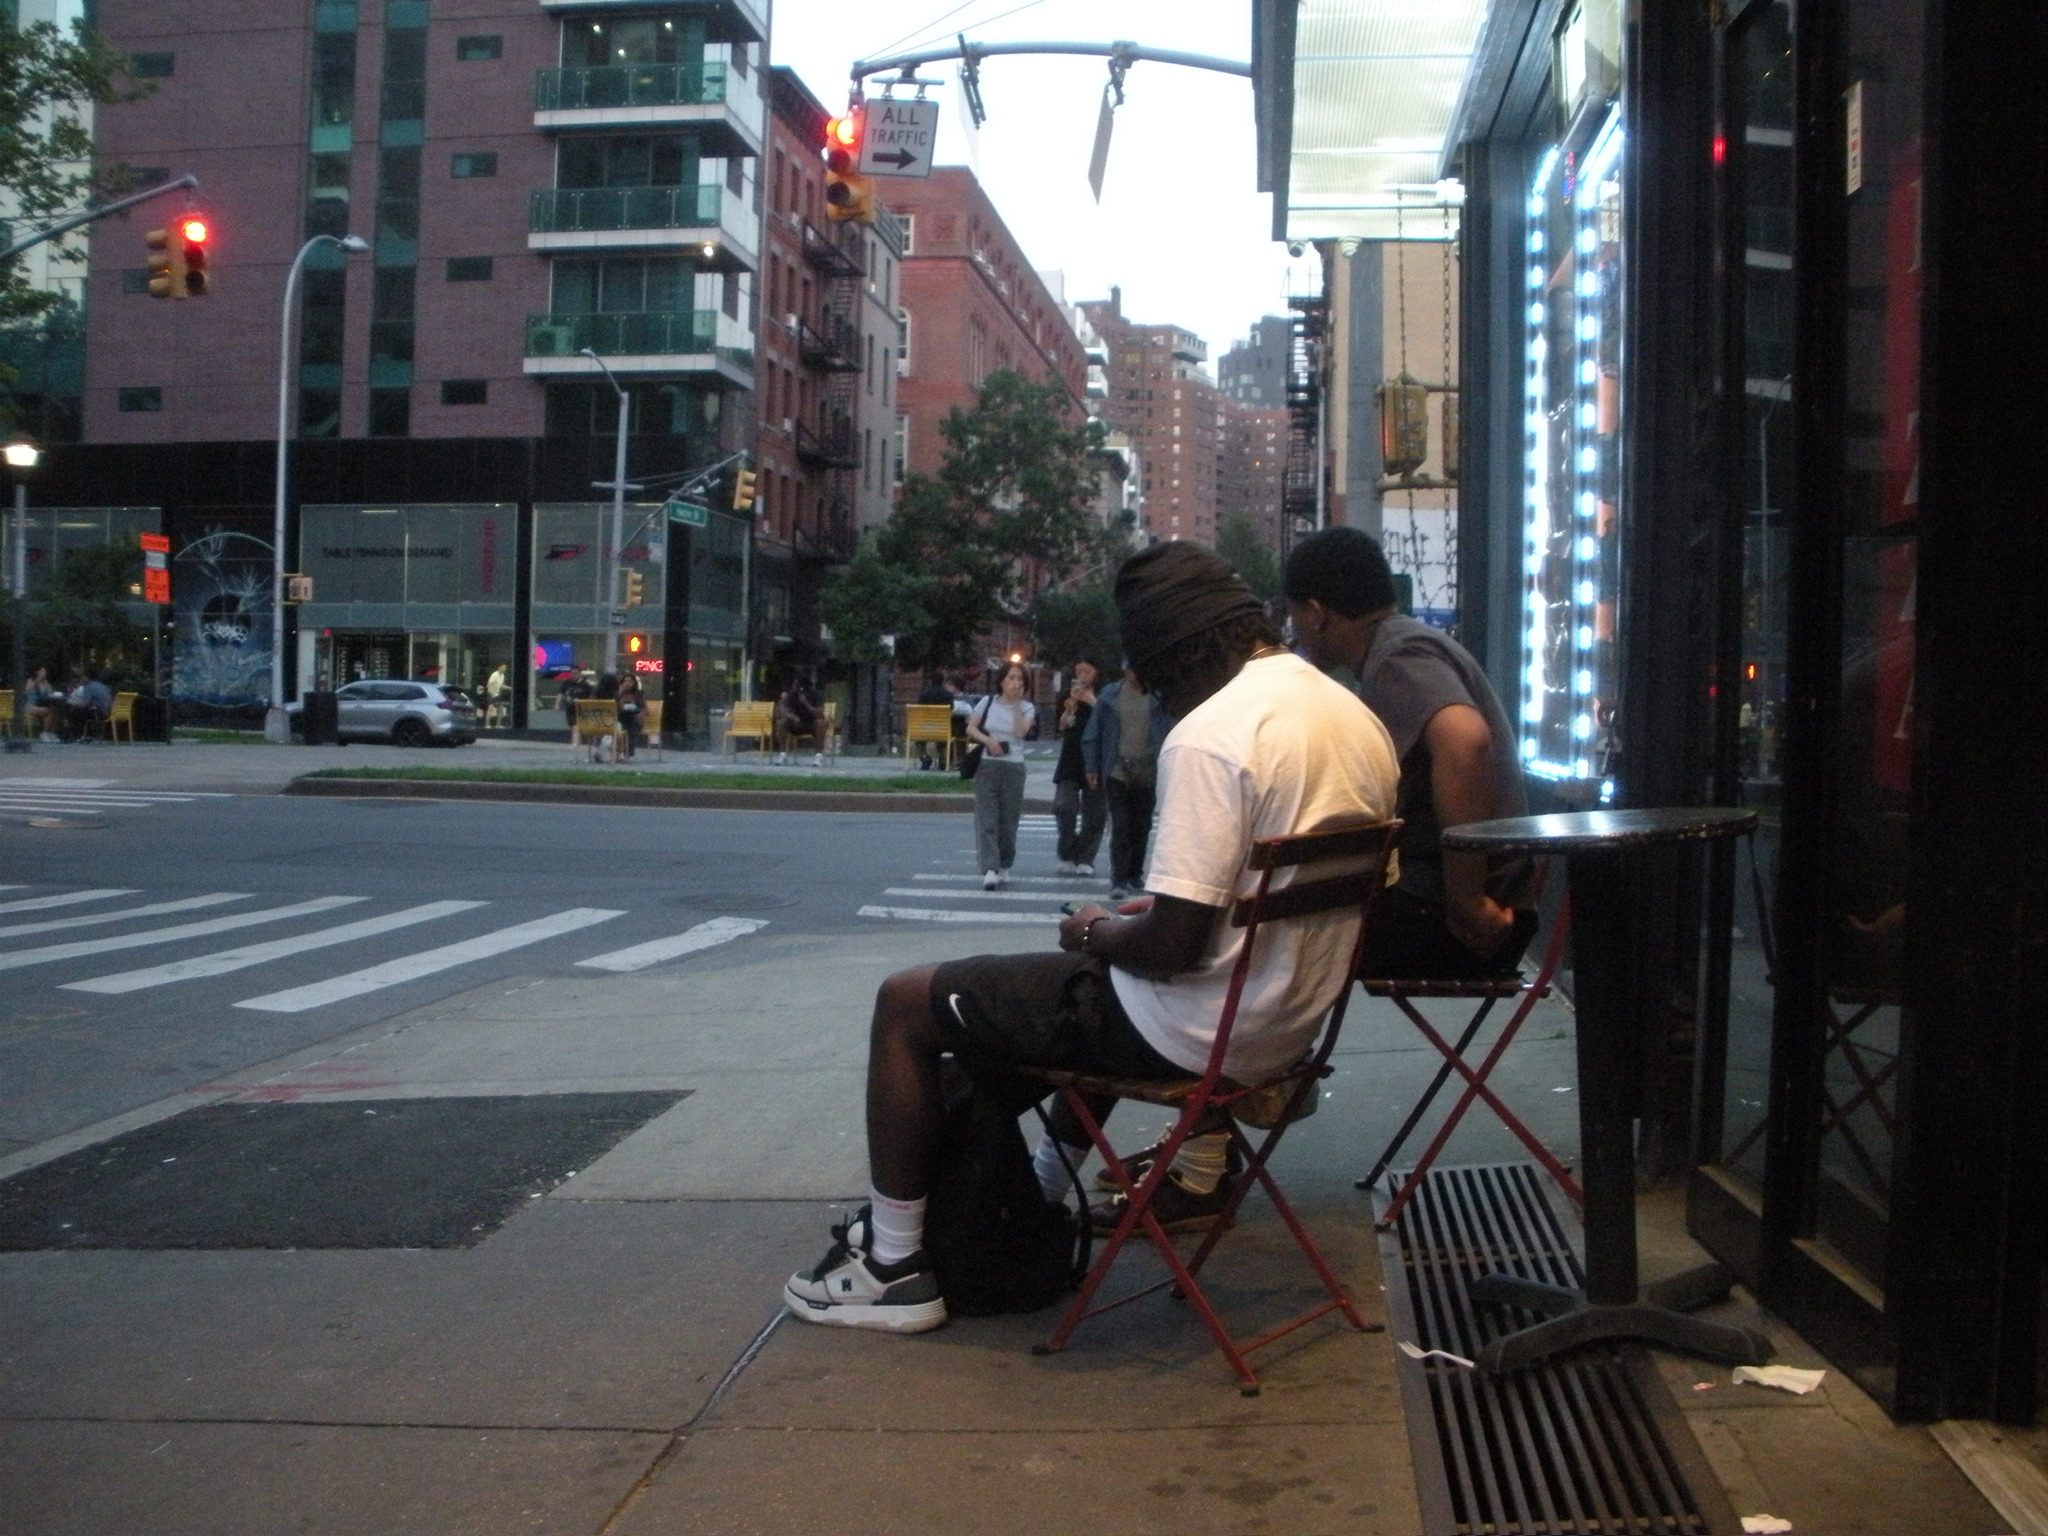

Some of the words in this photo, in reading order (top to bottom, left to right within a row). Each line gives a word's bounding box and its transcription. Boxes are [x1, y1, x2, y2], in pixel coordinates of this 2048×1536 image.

[881, 106, 920, 125] ALL
[871, 128, 928, 146] TRAFFIC
[322, 547, 351, 559] TABLE
